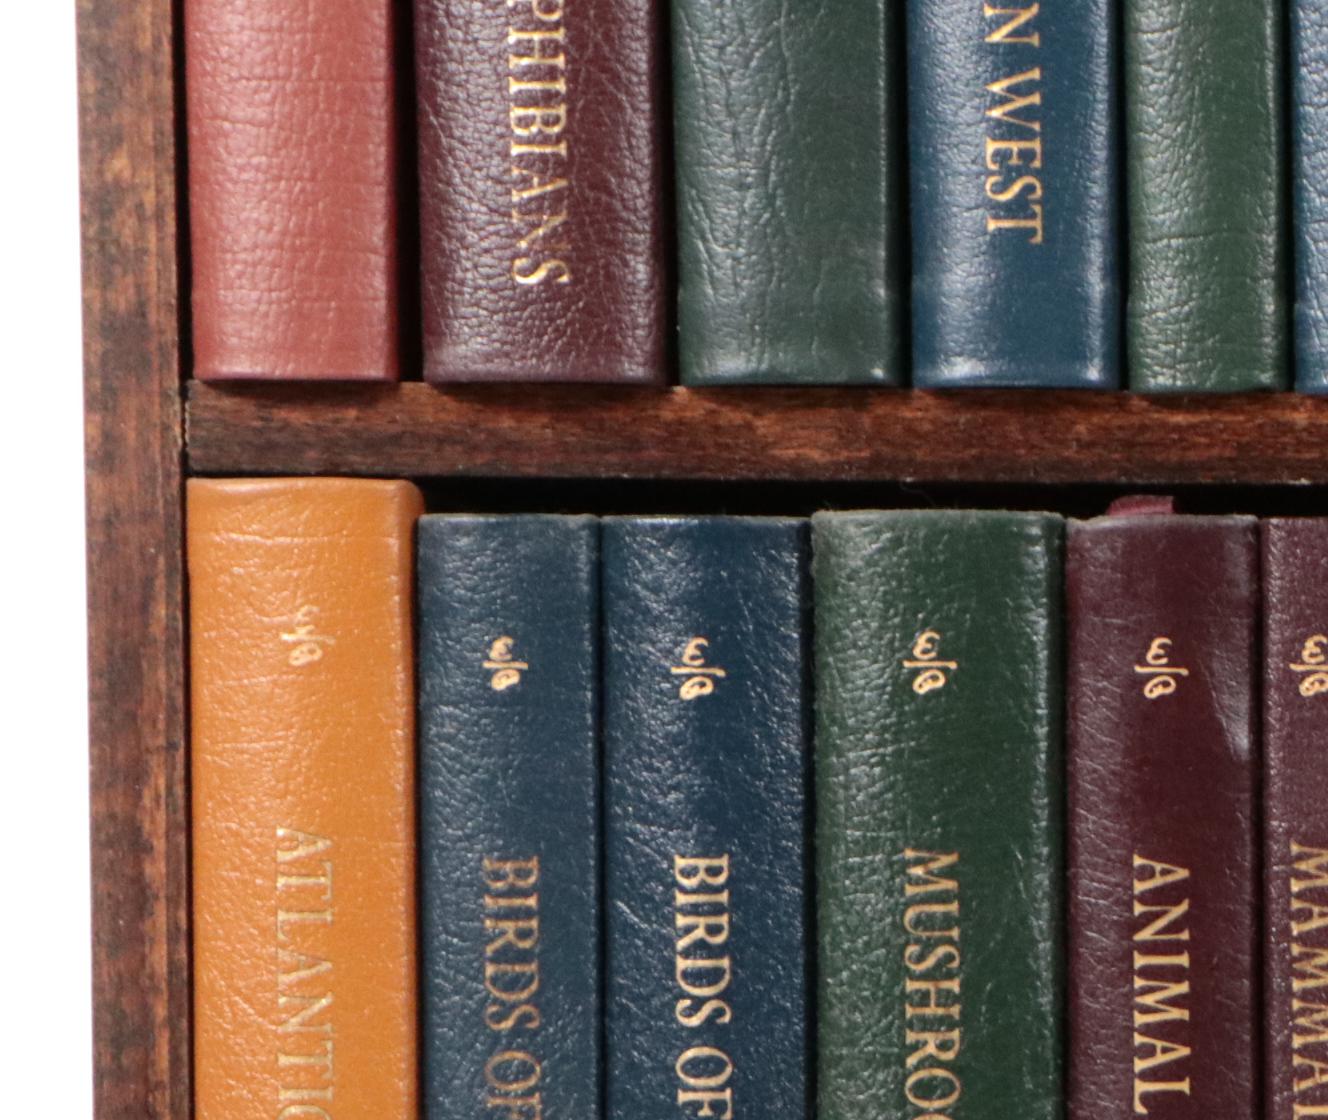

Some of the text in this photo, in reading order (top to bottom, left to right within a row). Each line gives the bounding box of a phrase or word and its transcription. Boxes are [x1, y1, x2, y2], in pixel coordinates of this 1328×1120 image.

[984, 66, 1044, 245] WEST
[482, 854, 541, 1033] BIRDS
[673, 853, 731, 1027] BIRDS
[1132, 854, 1191, 1114] ANIMAL
